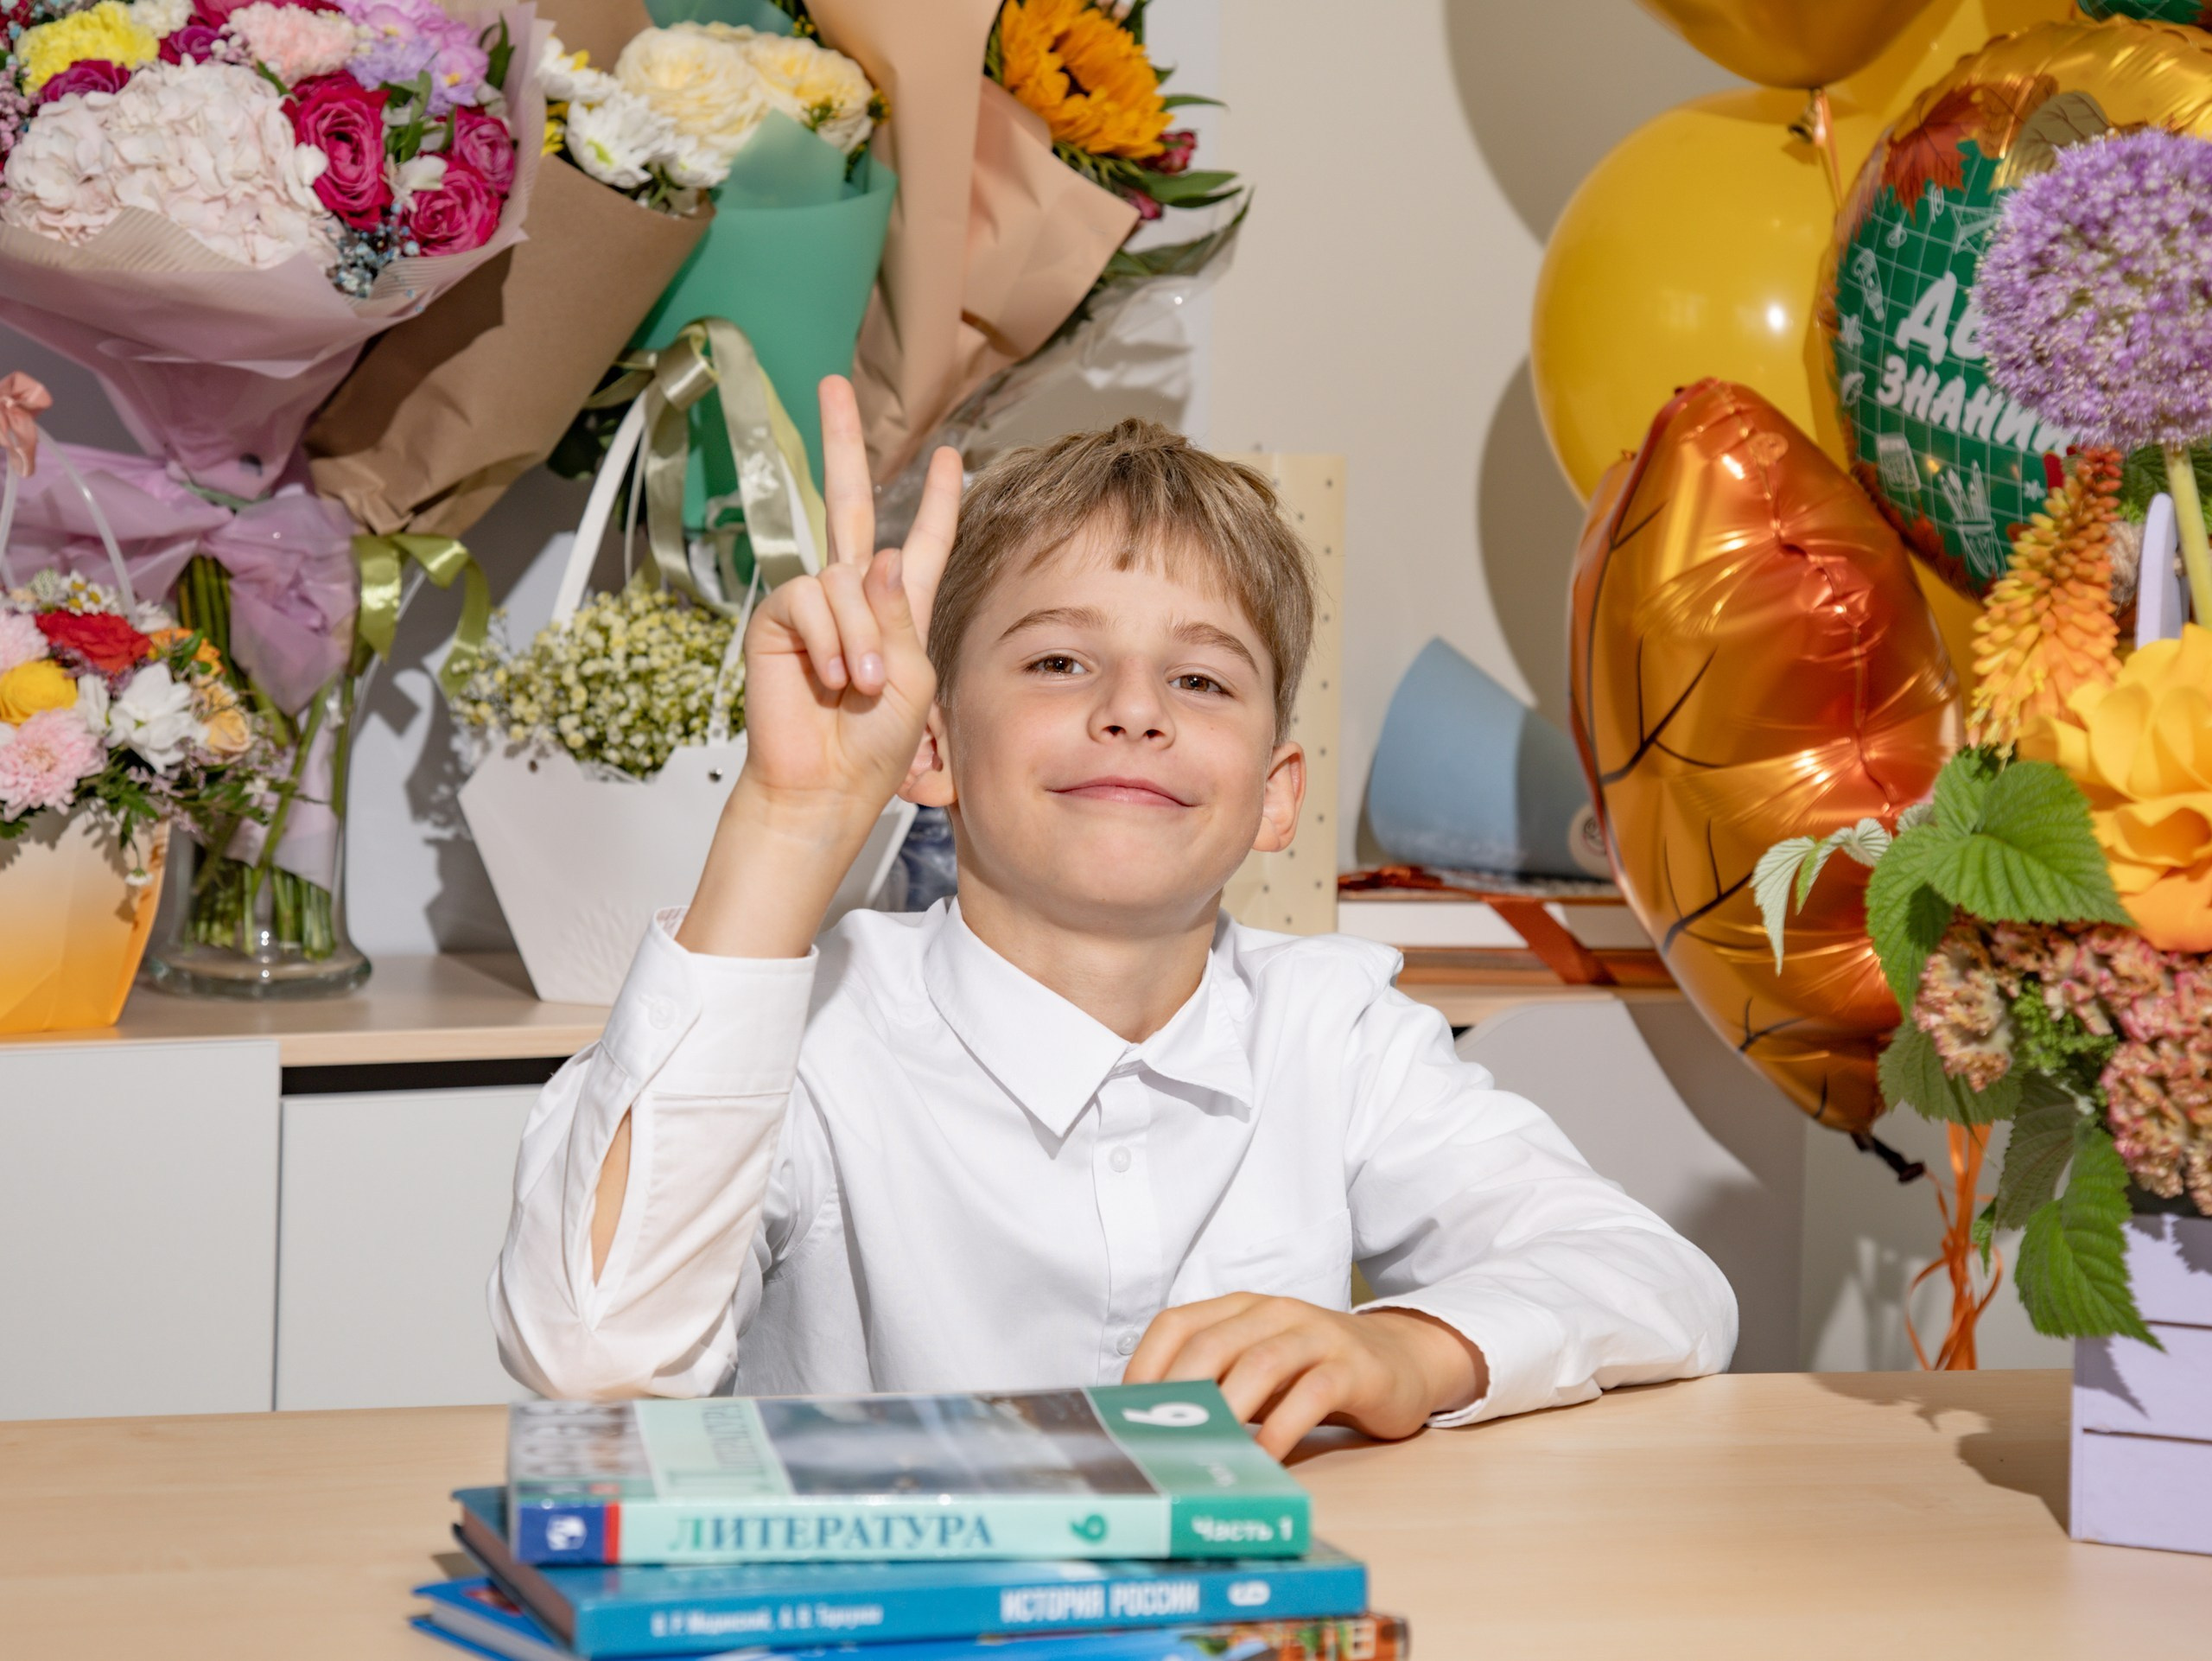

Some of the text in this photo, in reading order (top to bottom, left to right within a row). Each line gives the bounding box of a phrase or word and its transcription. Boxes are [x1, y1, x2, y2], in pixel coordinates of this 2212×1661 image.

[668, 1514, 993, 1551] ЛИТЕРАТУРА
[1192, 1516, 1274, 1542] Часть
[1279, 1515, 1294, 1542] 1
[1001, 1584, 1106, 1623] ИСТОРИЯ
[1109, 1580, 1199, 1617] РОССИИ
